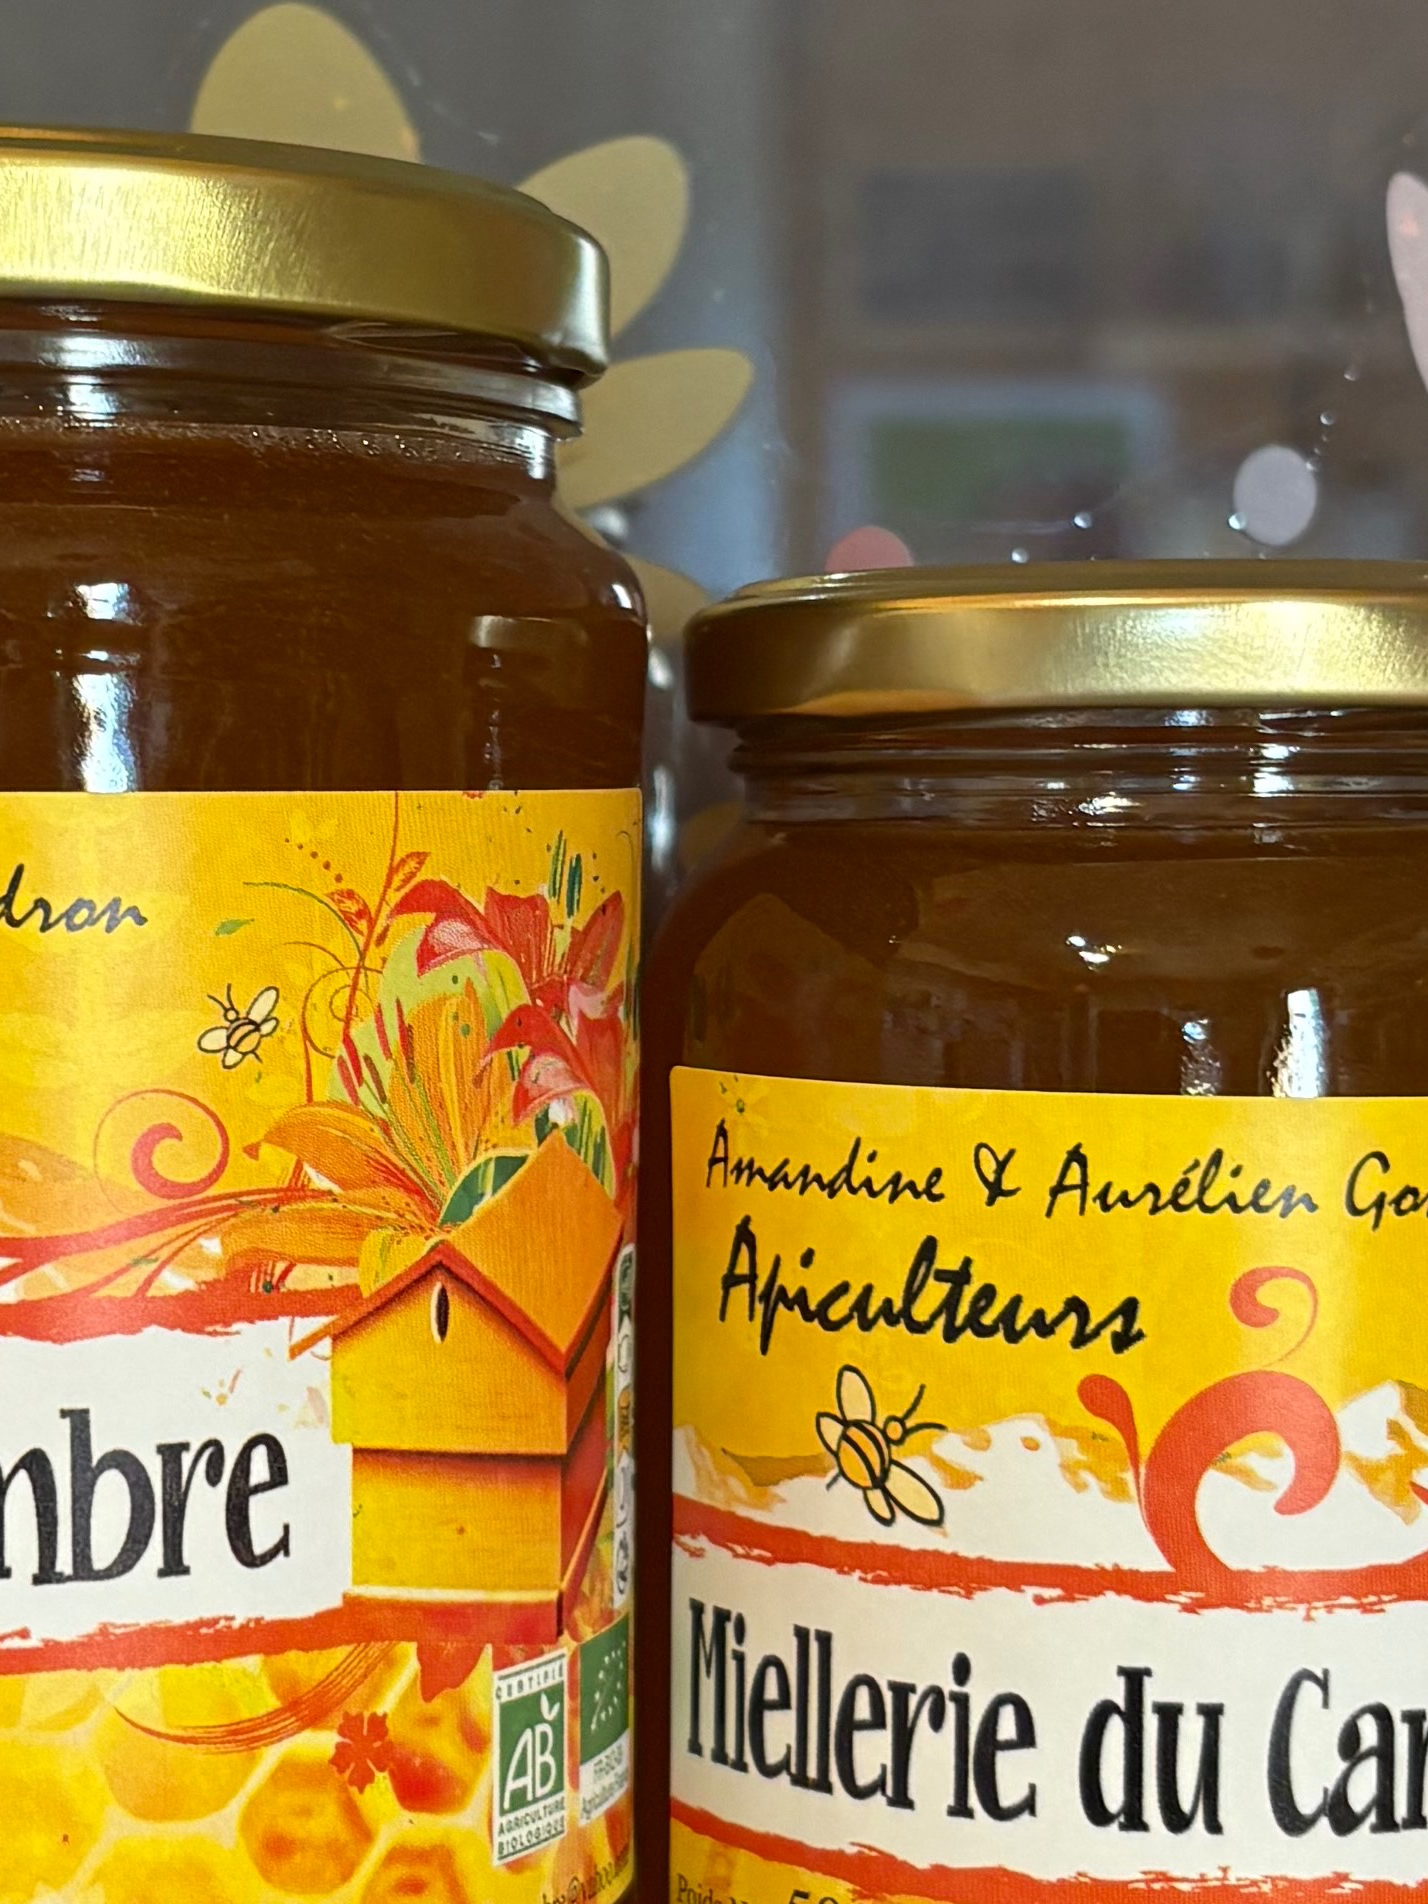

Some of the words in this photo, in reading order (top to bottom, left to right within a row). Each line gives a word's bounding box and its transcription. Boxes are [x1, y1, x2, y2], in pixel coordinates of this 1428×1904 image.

[706, 1118, 945, 1204] Amandine
[973, 1141, 1022, 1207] &
[1045, 1142, 1319, 1219] Aurélien
[718, 1214, 1146, 1357] Apiculteurs
[687, 1597, 1037, 1821] Miellerie
[1078, 1665, 1224, 1835] du
[503, 1722, 557, 1810] AB
[498, 1796, 565, 1838] AGRICULTURE
[498, 1815, 565, 1856] BIOLOGIQUE
